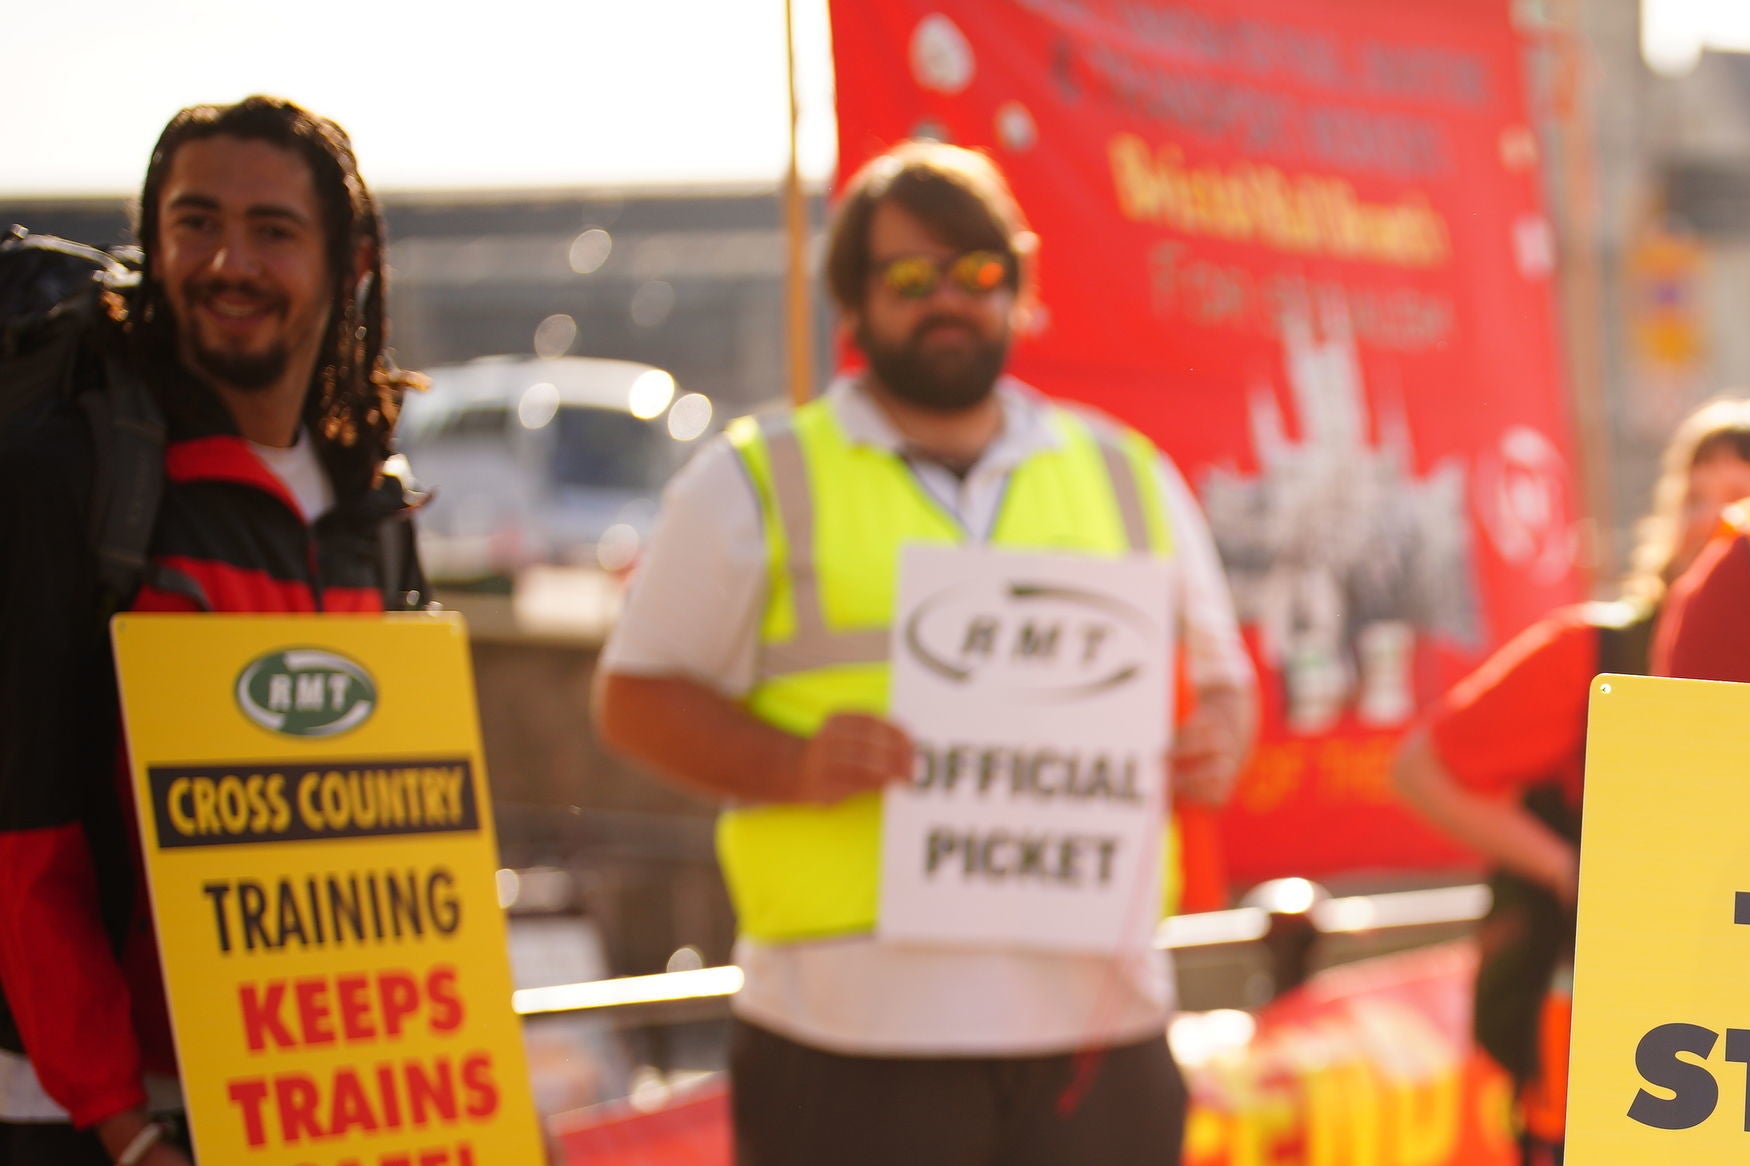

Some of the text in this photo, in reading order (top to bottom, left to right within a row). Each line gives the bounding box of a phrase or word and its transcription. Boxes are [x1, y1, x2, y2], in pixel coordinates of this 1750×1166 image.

[962, 614, 1110, 663] RMT
[267, 673, 353, 713] RMT
[166, 767, 465, 836] CROSS COUNTRY
[926, 828, 1121, 884] PICKET
[203, 866, 462, 955] TRAINING
[238, 963, 466, 1057] KEEPS
[228, 1051, 502, 1150] TRAINS
